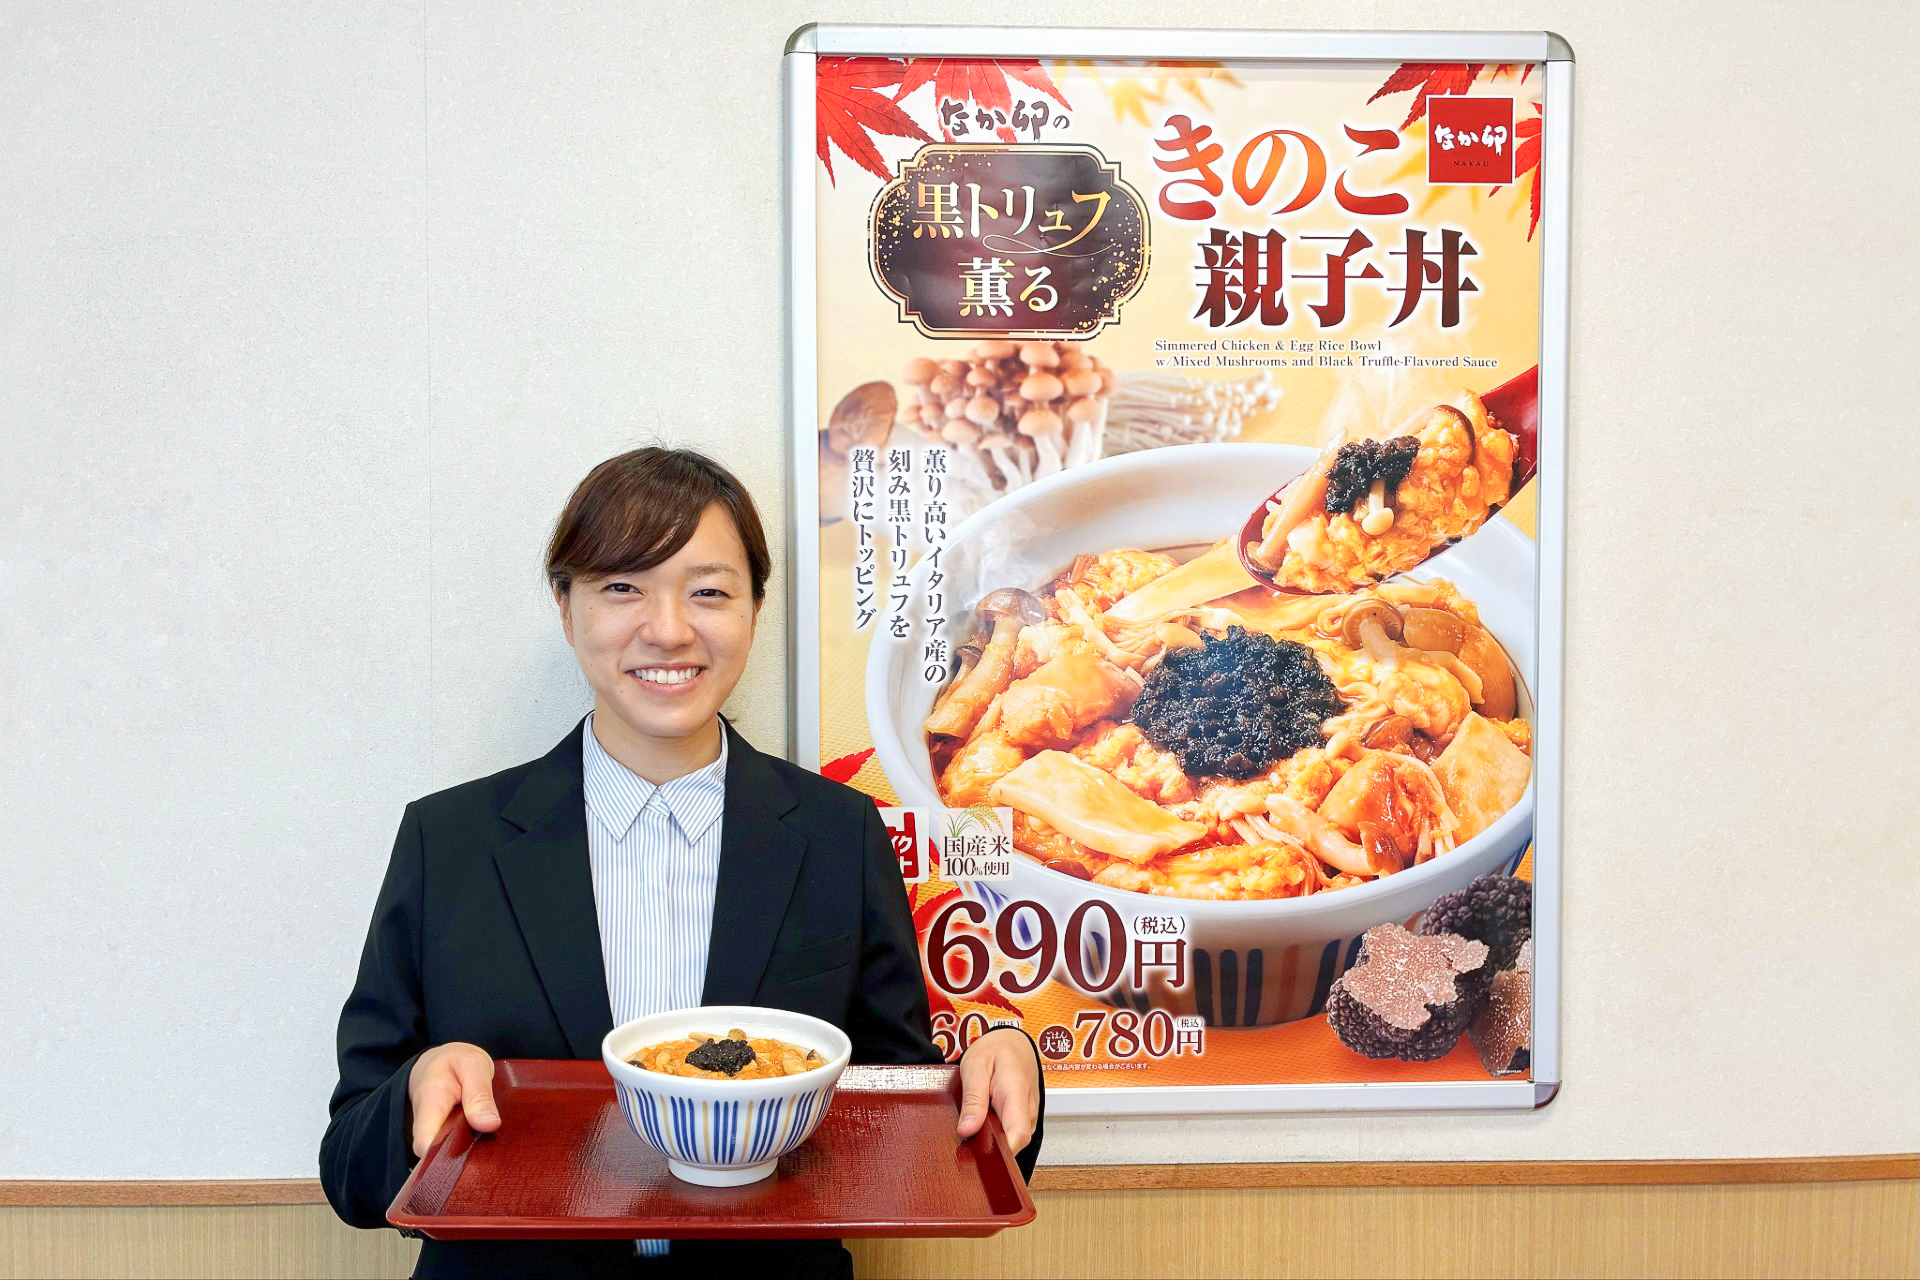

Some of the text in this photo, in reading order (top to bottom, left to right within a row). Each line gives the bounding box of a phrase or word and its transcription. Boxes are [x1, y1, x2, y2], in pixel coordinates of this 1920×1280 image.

[941, 98, 1070, 141] なか卯の
[1434, 124, 1508, 156] なか卯
[1153, 114, 1409, 221] きのこ
[912, 181, 1112, 251] 黒トリュフ
[957, 257, 1058, 317] 薫る
[1193, 228, 1479, 328] 親子丼
[1155, 340, 1382, 353] Simmered Chicken & Egg Rice Bowl
[1155, 356, 1498, 368] w/Mixed Mushrooms and Black Truffle-Flavored Sauce
[852, 449, 877, 630] 贅沢にトッピング
[888, 449, 911, 639] 刻み黒トリュフを
[923, 449, 947, 684] 薫り高いイタリア産の
[944, 835, 1010, 857] 国産米
[944, 857, 1010, 877] 100%使用
[927, 899, 1187, 995] 690円
[1133, 916, 1186, 935] (税込)
[1045, 1031, 1068, 1039] ごはん
[1075, 1010, 1203, 1058] 780円
[1176, 1018, 1204, 1028] (税込)
[1042, 1038, 1071, 1053] 大盛
